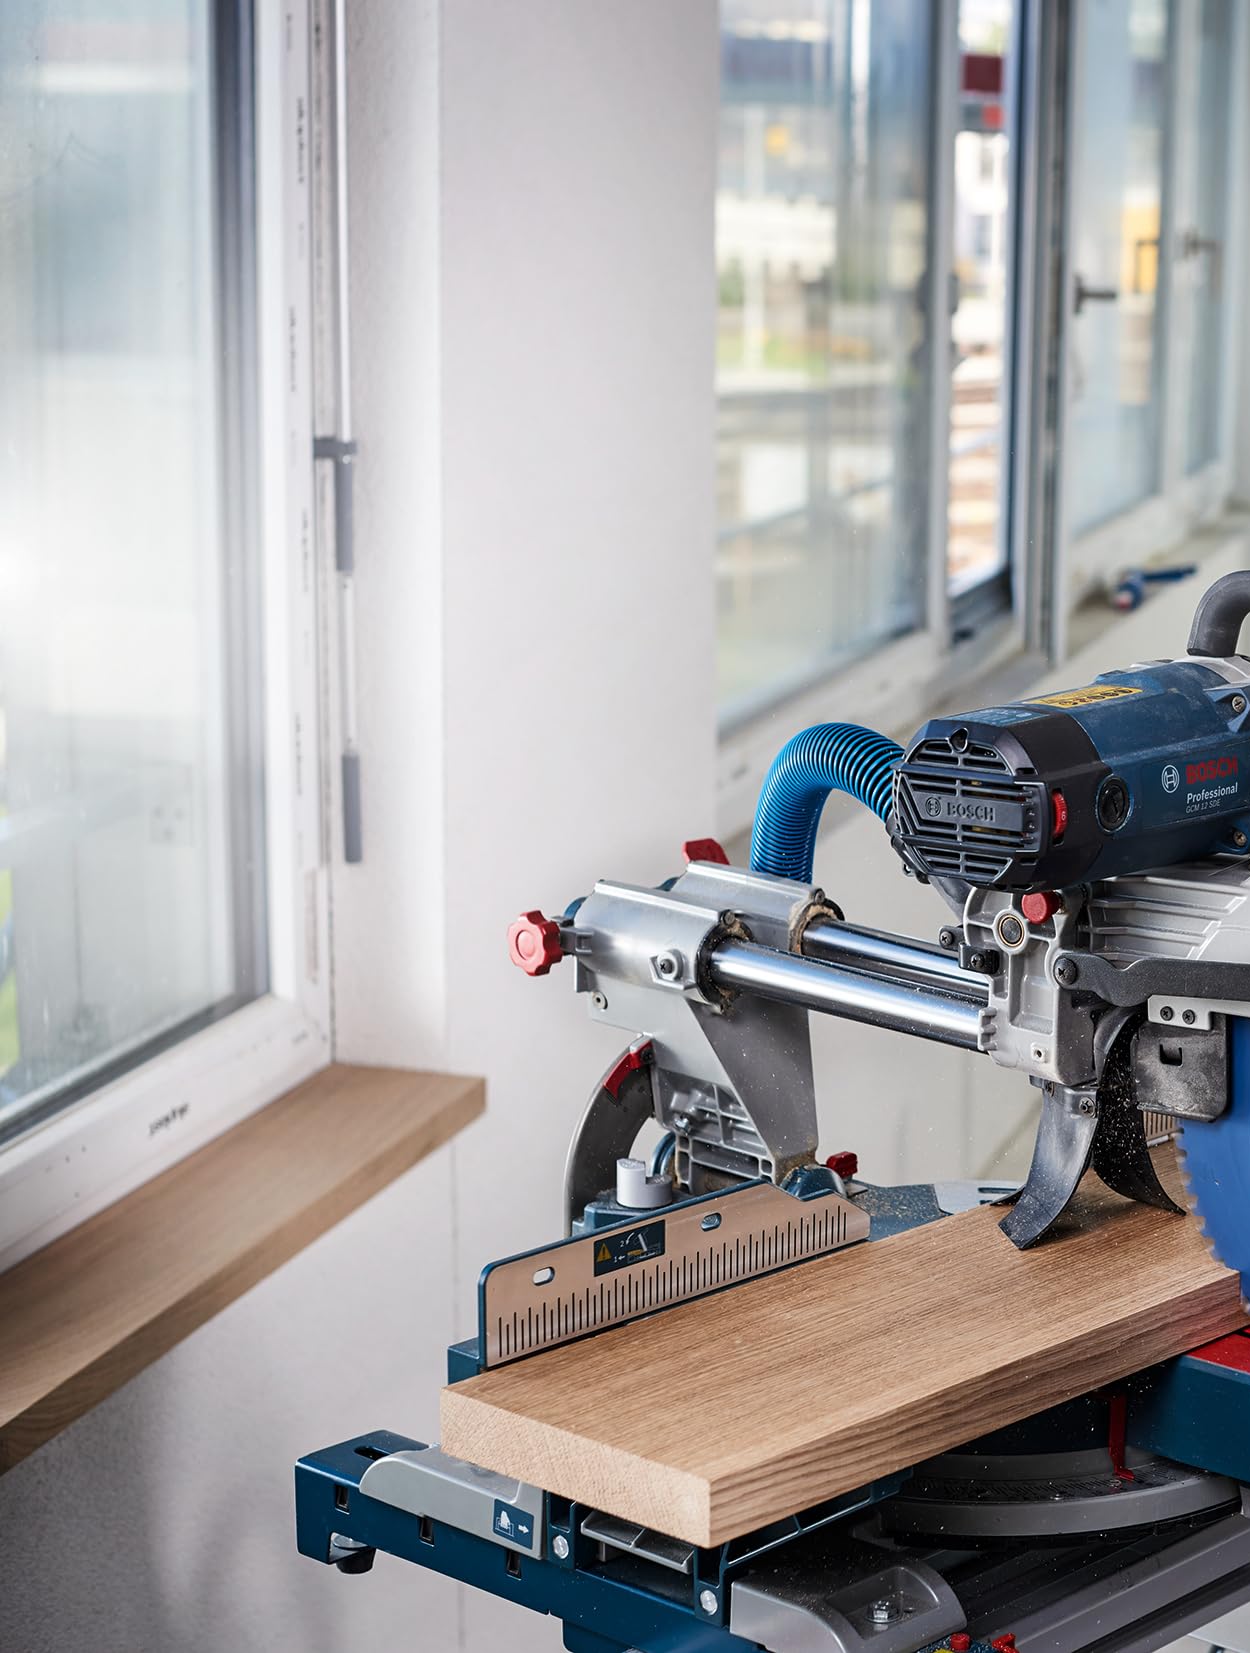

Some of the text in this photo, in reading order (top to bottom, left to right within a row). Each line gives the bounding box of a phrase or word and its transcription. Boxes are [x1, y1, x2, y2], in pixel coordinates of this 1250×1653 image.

[1185, 755, 1238, 784] BOSCH
[1186, 782, 1238, 804] Professional
[946, 802, 995, 822] BOSCH
[1185, 803, 1200, 814] GCM
